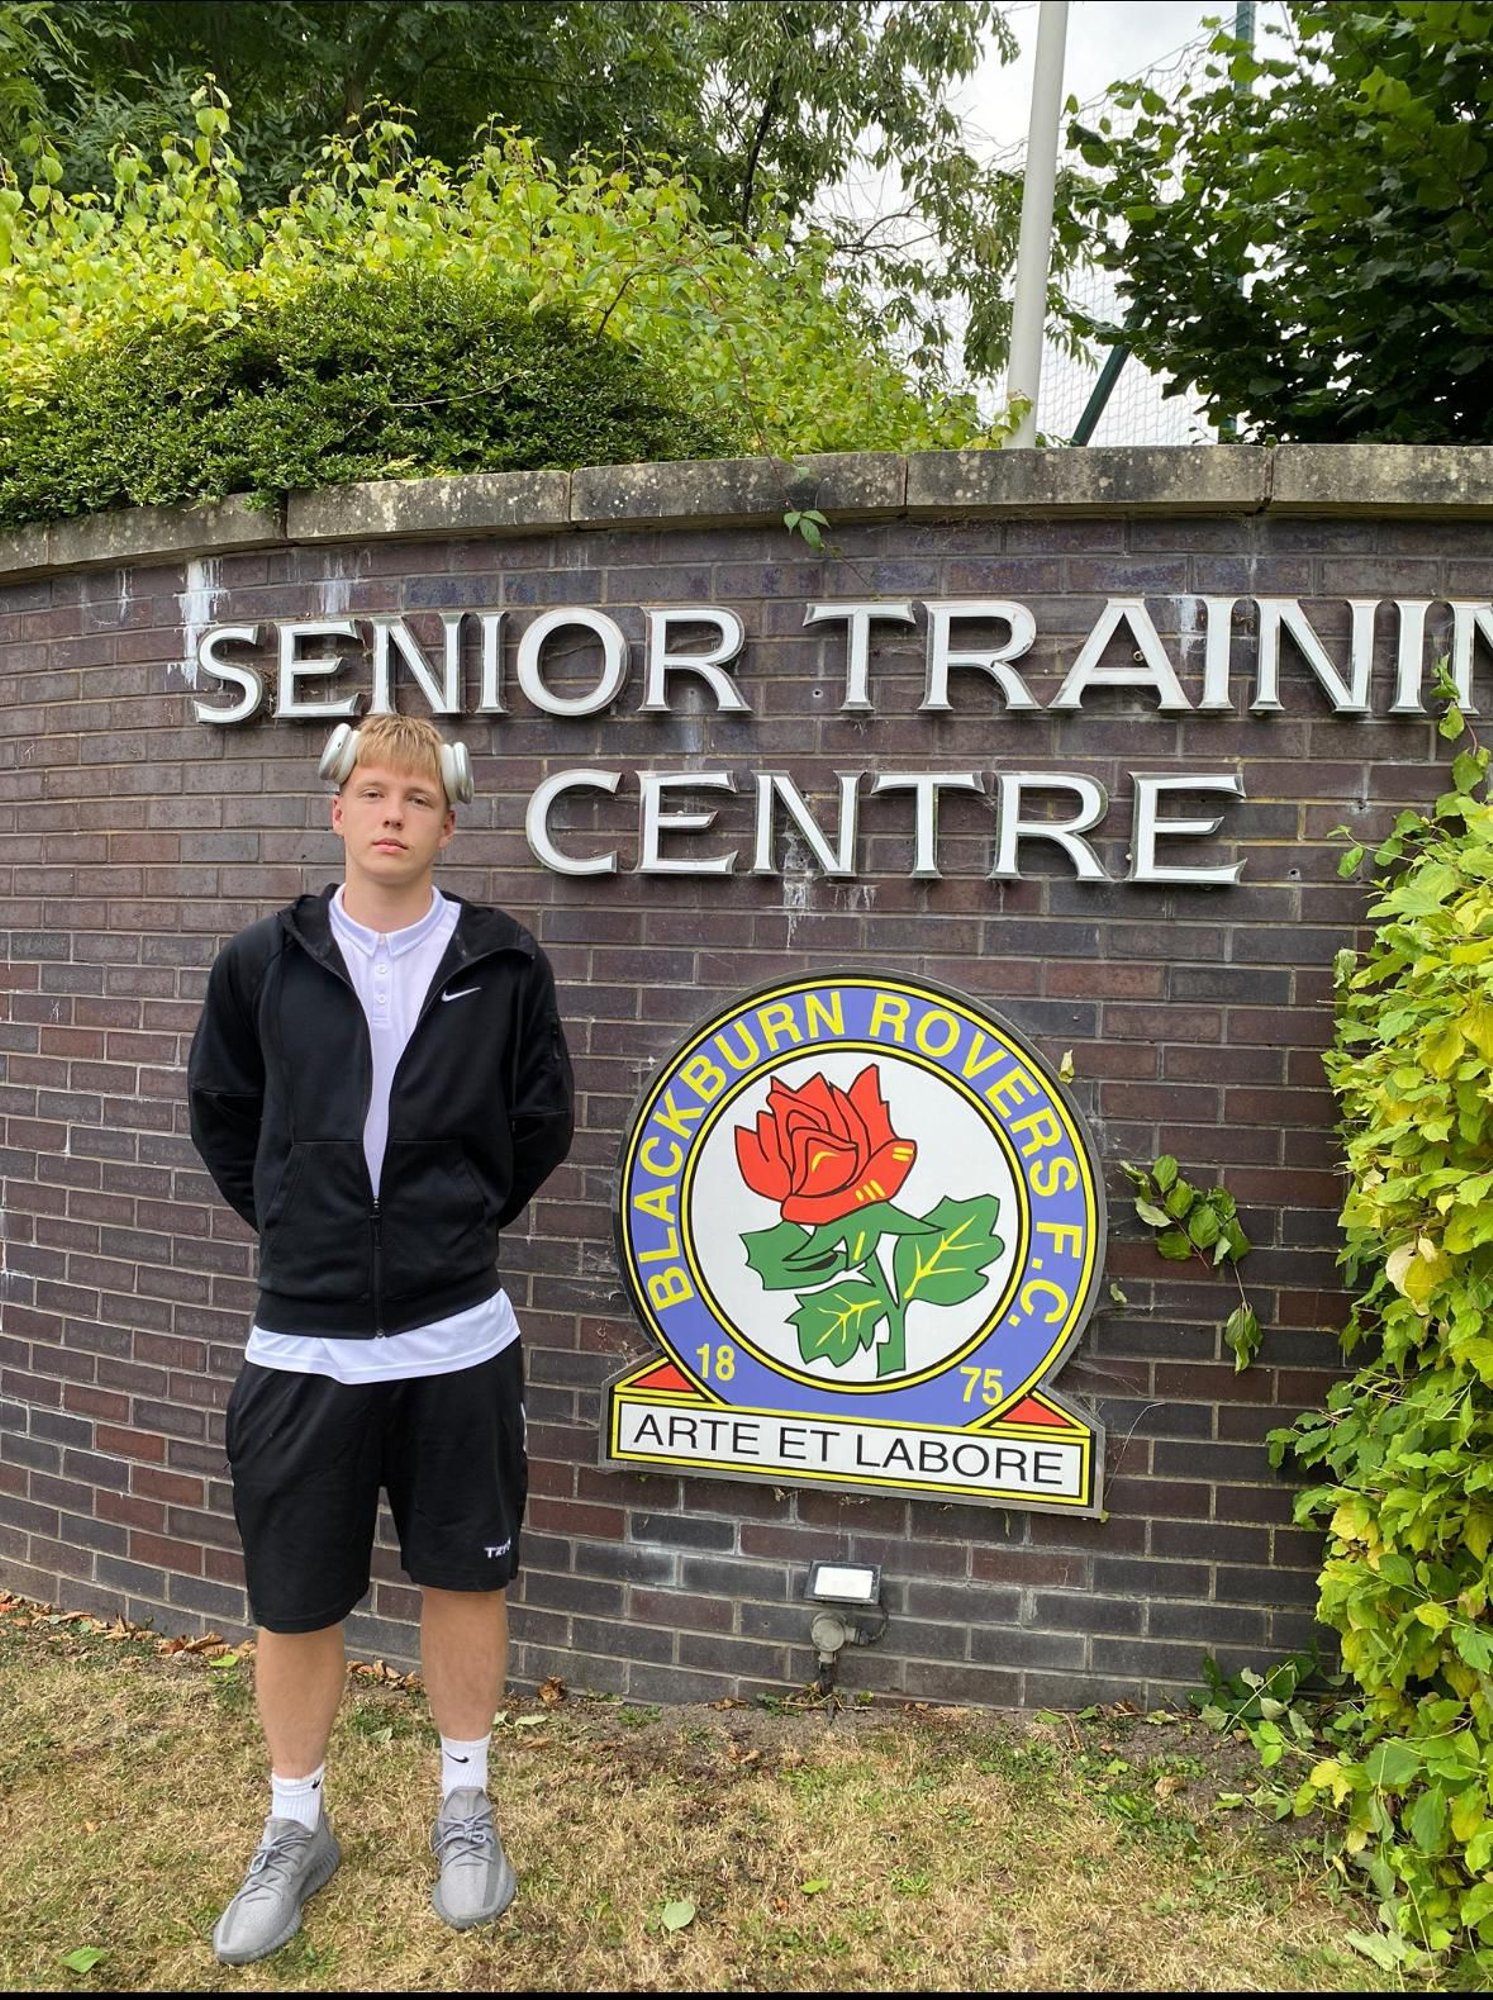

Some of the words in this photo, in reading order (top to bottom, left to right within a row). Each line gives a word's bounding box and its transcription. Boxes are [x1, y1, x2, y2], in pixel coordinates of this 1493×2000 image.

[194, 606, 753, 724] SENIOR
[525, 768, 1247, 885] CENTRE
[632, 991, 845, 1311] BLACKBURN
[869, 992, 1081, 1197] ROVERS
[1008, 1221, 1084, 1327] F.C.
[696, 1343, 736, 1382] 18
[959, 1366, 1004, 1408] 75
[633, 1414, 760, 1455] ARTE
[779, 1426, 840, 1462] ET
[856, 1434, 1063, 1485] LABORE
